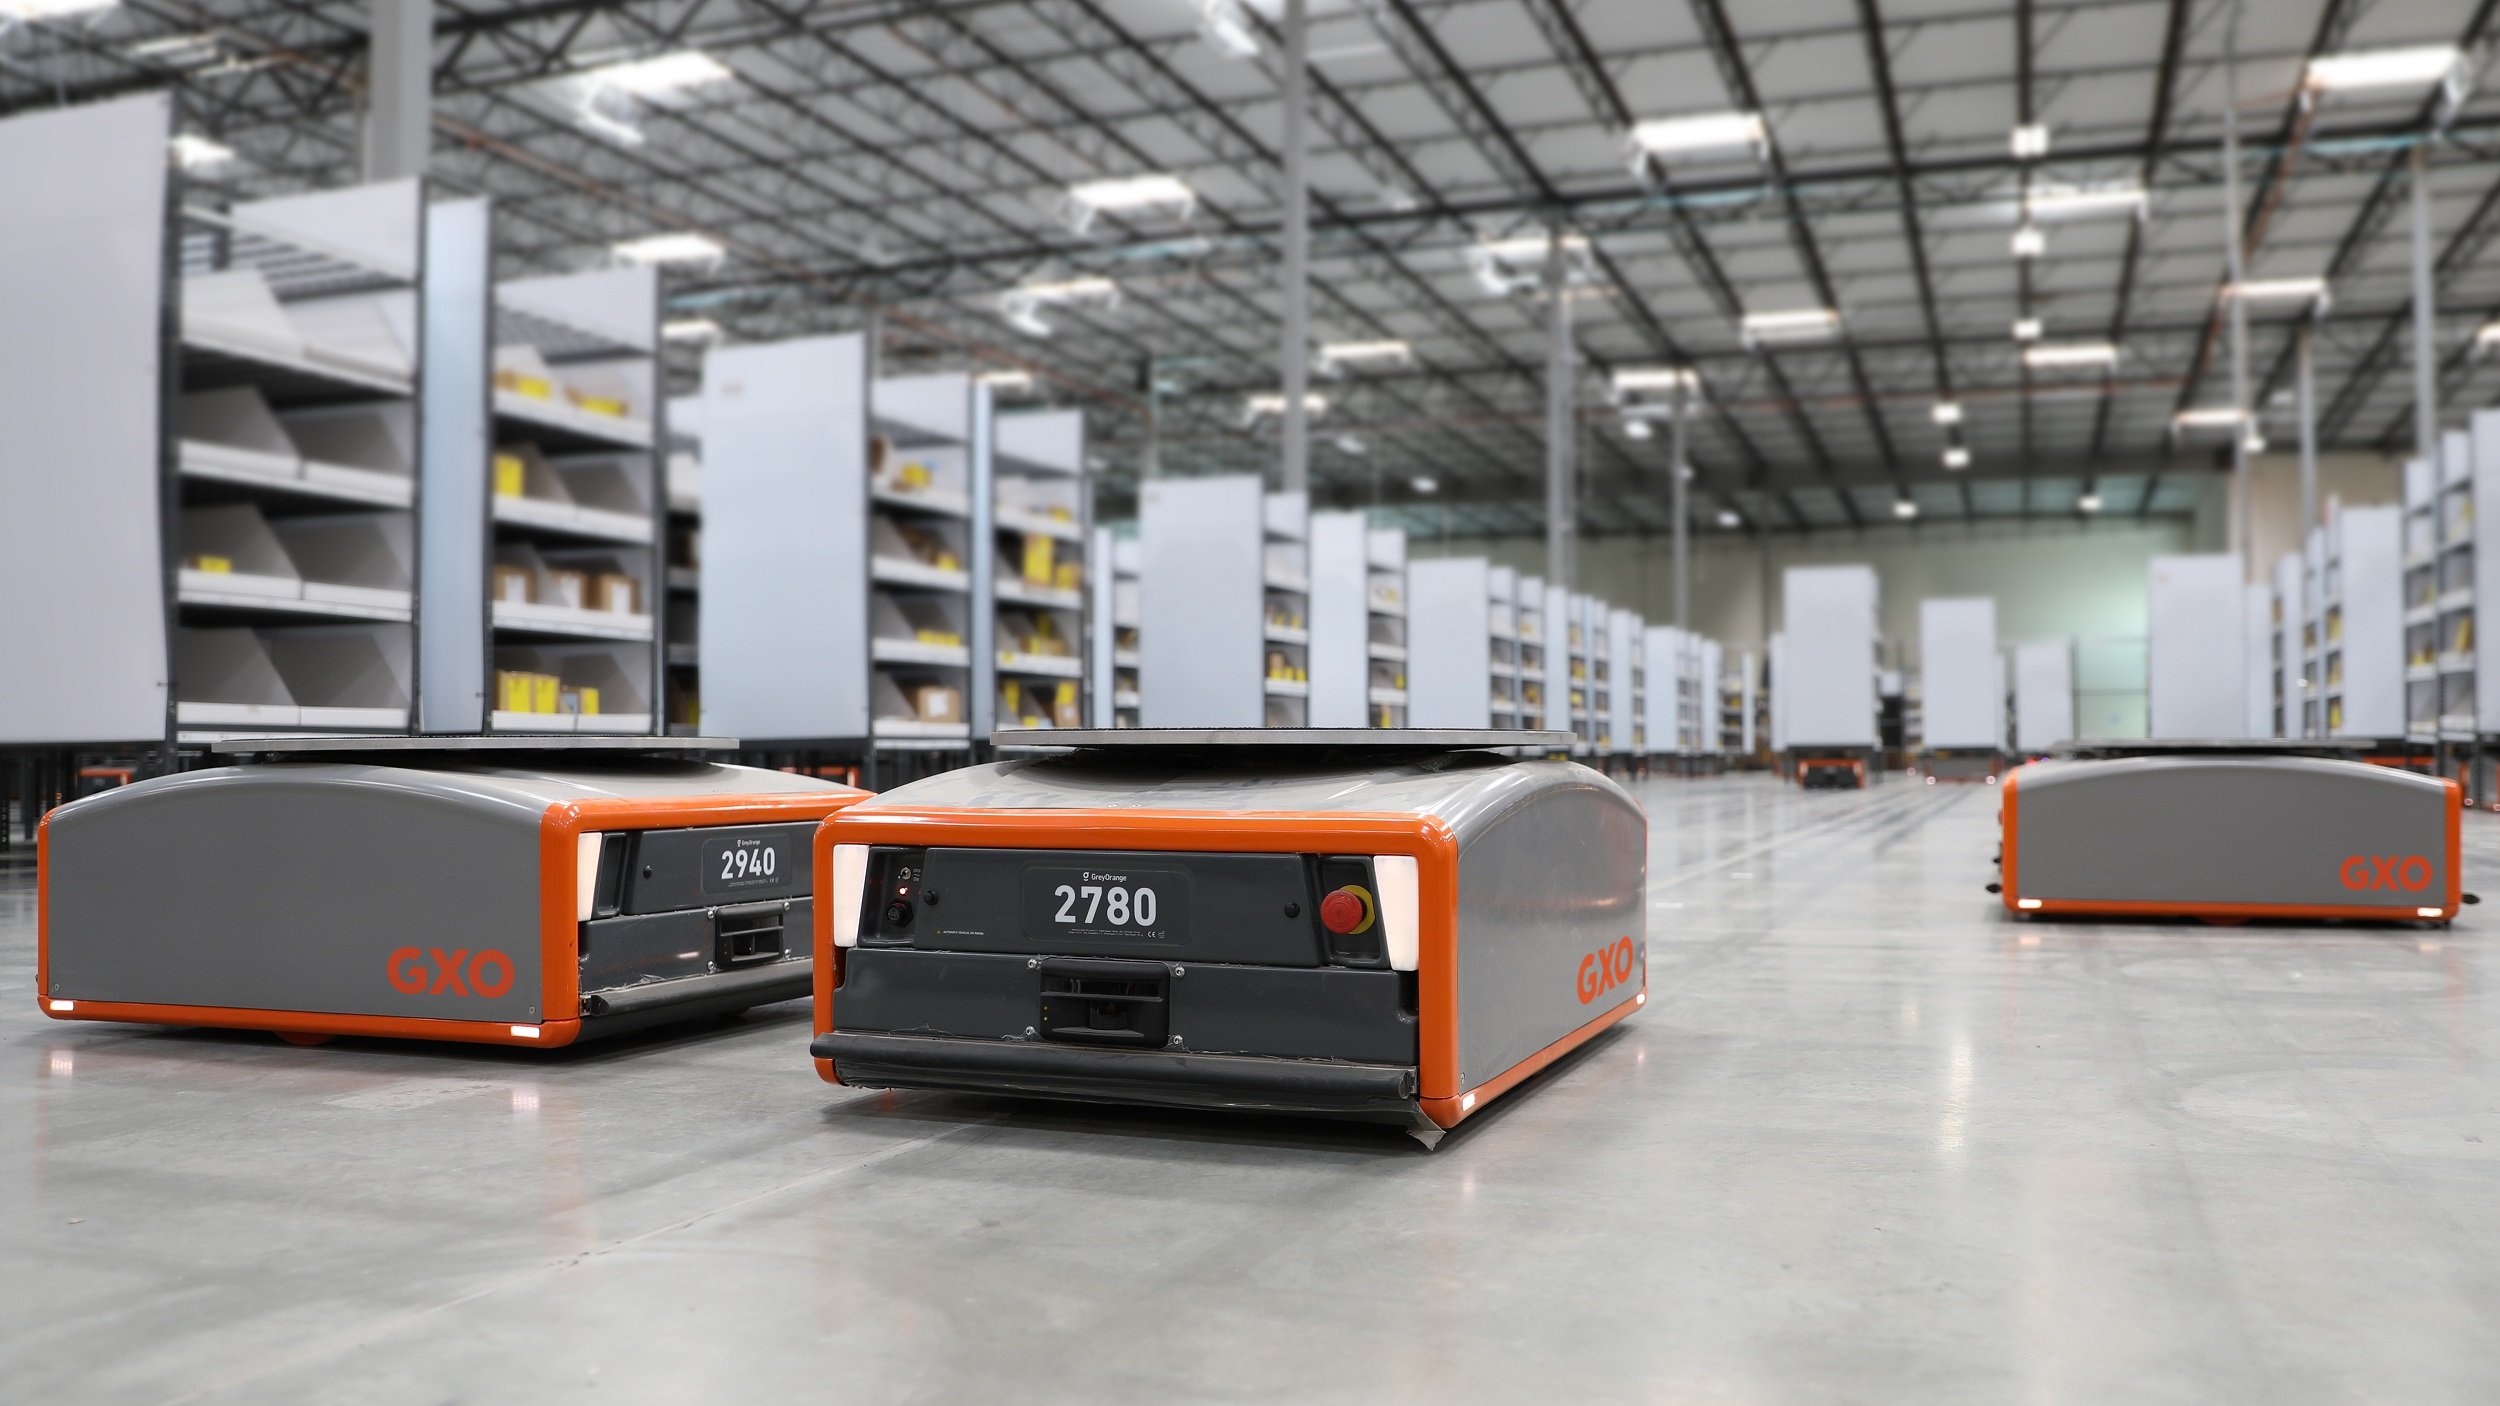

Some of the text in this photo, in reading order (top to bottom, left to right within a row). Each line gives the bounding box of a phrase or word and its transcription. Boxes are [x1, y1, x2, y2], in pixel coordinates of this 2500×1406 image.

[721, 847, 775, 880] 2940
[1091, 873, 1127, 882] GreyOrange
[2340, 854, 2433, 892] GXO
[1054, 884, 1157, 927] 2780
[386, 946, 515, 999] GXO
[1577, 935, 1633, 1005] GXO
